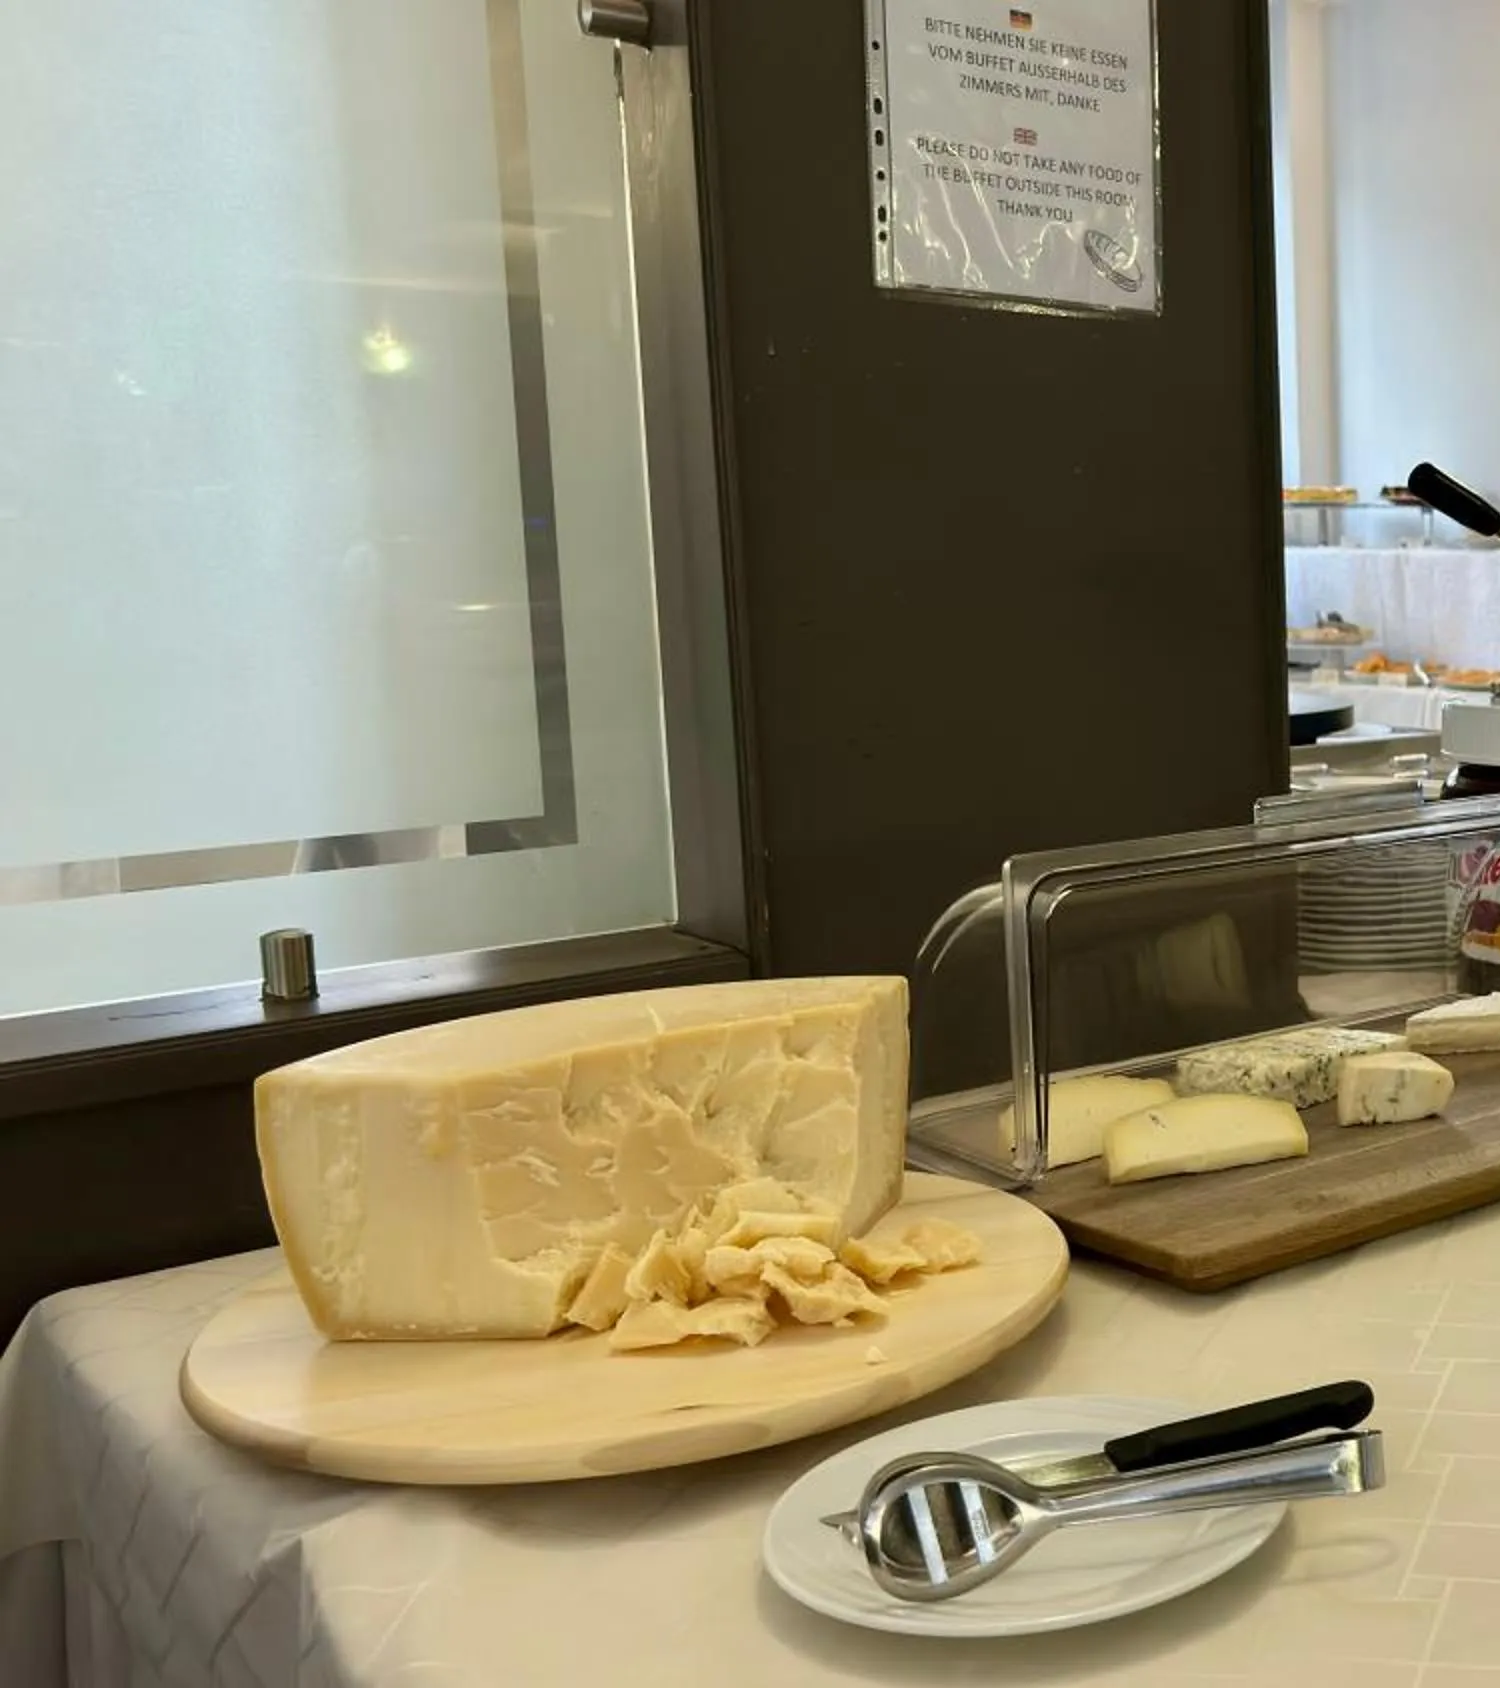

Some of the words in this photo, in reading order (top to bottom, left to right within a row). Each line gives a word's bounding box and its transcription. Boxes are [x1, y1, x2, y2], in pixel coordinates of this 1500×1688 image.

[925, 17, 961, 37] BITTE
[965, 25, 1025, 50] NEHMEN
[1028, 38, 1048, 54] SIE
[1051, 42, 1087, 62] KEINE
[1091, 49, 1128, 71] ESSEN
[927, 42, 963, 62] VOM
[965, 50, 1015, 73] BUFFET
[1019, 61, 1100, 88] AUSSERHALB
[1103, 76, 1127, 93] DES
[959, 74, 1021, 98] ZIMMERS
[1057, 91, 1101, 112] DANKE
[917, 137, 966, 156] PLEASE
[969, 145, 989, 161] DO
[993, 149, 1020, 166] NOT
[1023, 154, 1057, 172] TAKE
[1060, 160, 1086, 176] ANY
[1126, 170, 1143, 185] OF
[953, 167, 1002, 189] BUFFET
[1005, 176, 1061, 197] OUTSIDE
[1065, 185, 1093, 203] THIS
[997, 199, 1042, 217] THANK
[1045, 206, 1073, 222] YOU
